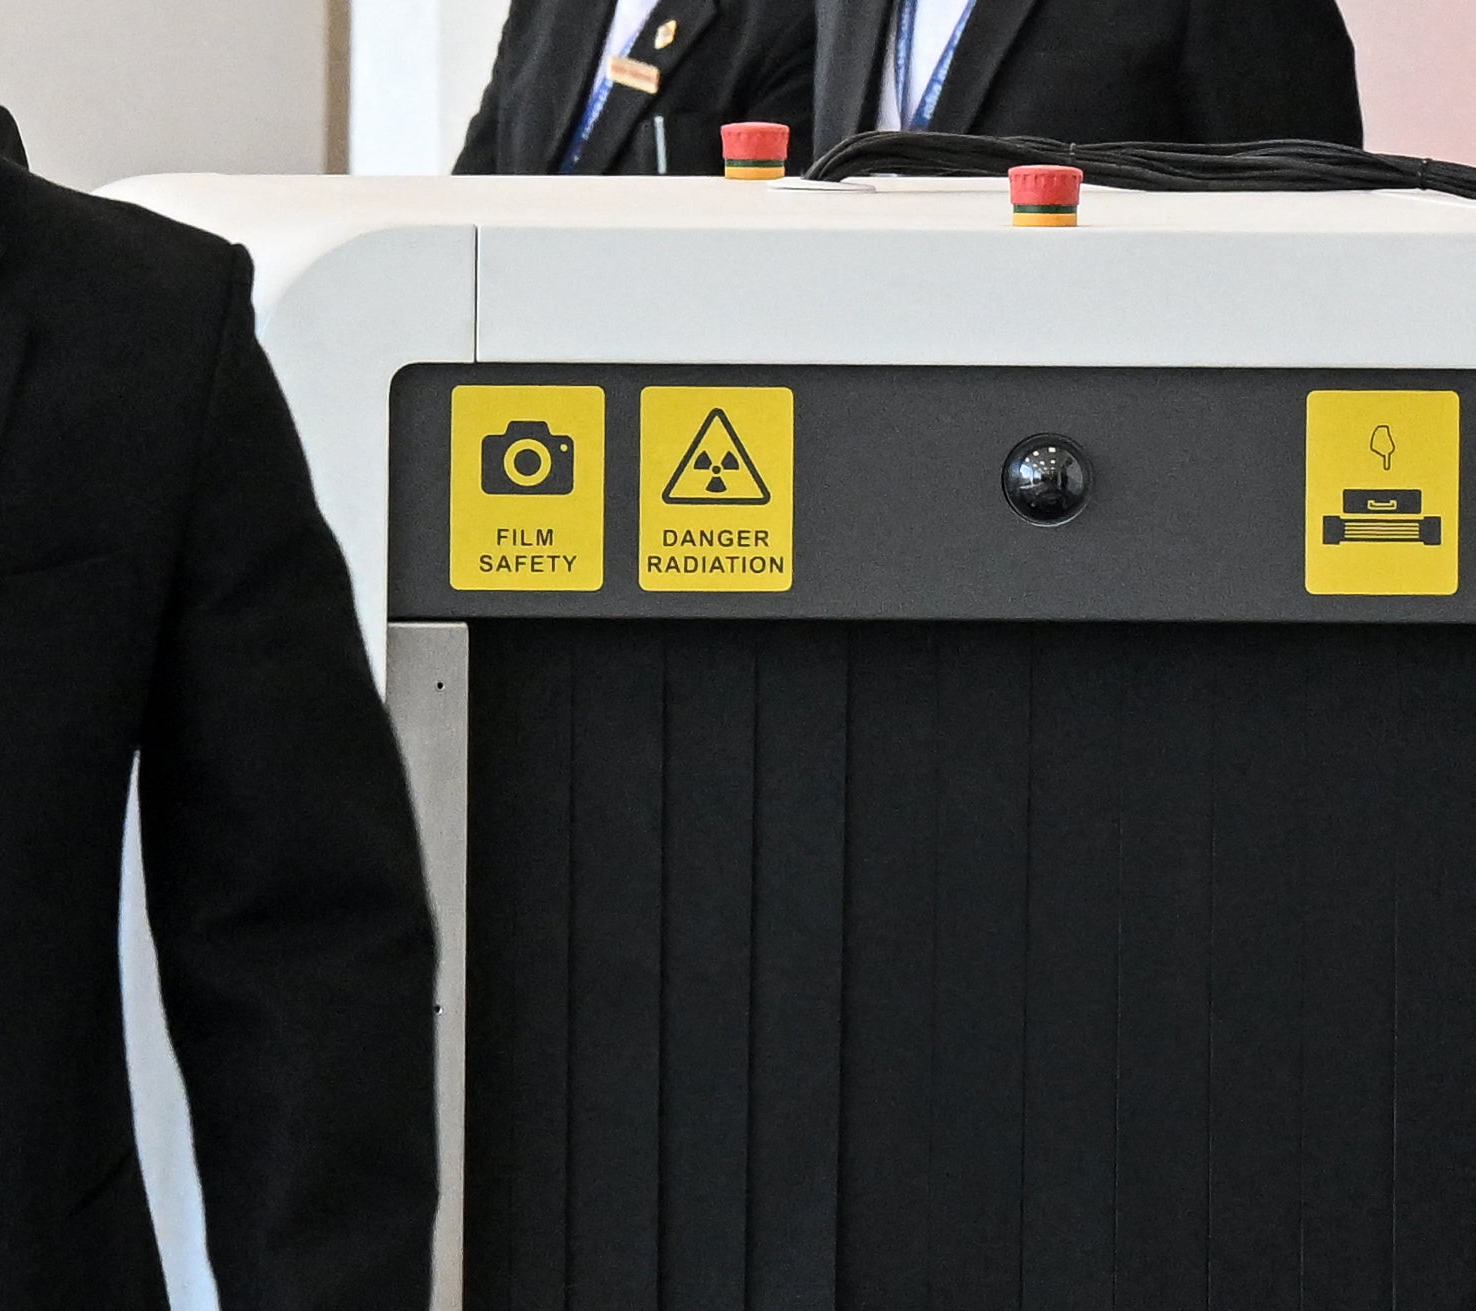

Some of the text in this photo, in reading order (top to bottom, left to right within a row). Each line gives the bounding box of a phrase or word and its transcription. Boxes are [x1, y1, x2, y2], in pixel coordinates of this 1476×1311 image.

[496, 528, 555, 546] FILM
[662, 529, 770, 547] DANGER
[478, 554, 578, 573] SAFETY
[647, 555, 785, 573] RADIATION
